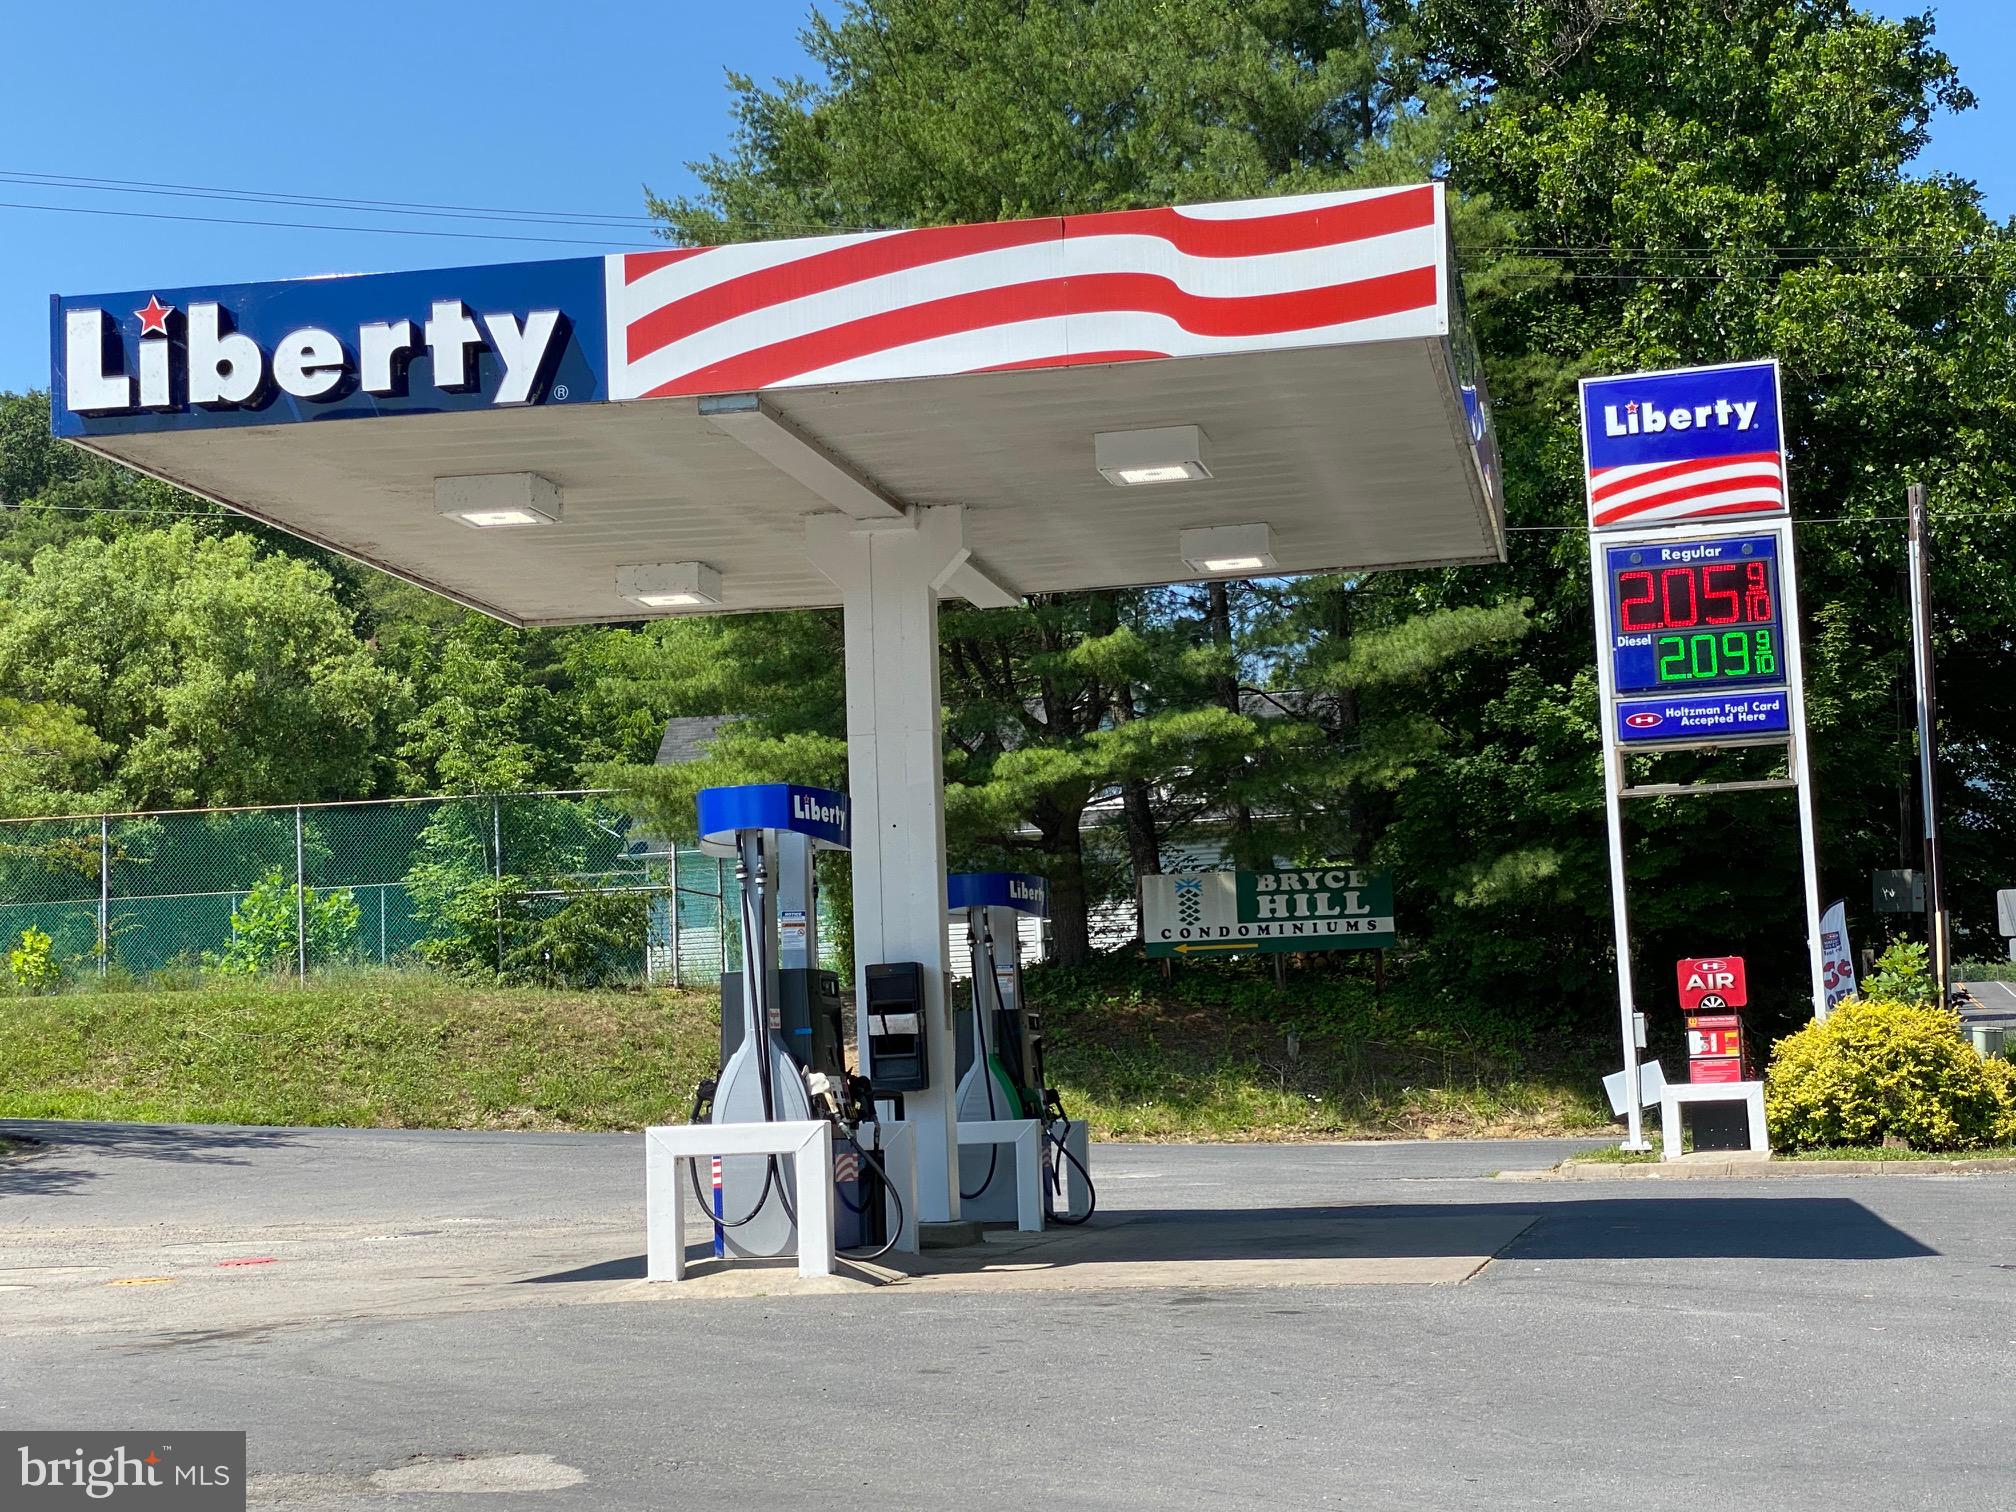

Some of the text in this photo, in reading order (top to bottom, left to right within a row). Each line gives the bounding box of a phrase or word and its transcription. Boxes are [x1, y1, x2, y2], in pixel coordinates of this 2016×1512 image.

[66, 293, 562, 412] Liberty
[1604, 399, 1757, 437] Liberty
[1661, 545, 1721, 561] Regular
[1617, 633, 1651, 647] Diesel
[1665, 700, 1779, 717] Holtzman Fuel Card
[1681, 712, 1766, 726] Accepted Here
[793, 794, 845, 831] Liberty
[1256, 869, 1368, 891] BRYCE
[1009, 879, 1044, 906] Liberty
[1256, 890, 1370, 918] HILL
[1160, 918, 1378, 941] CONDOMINIUMS
[1685, 972, 1735, 991] AIR
